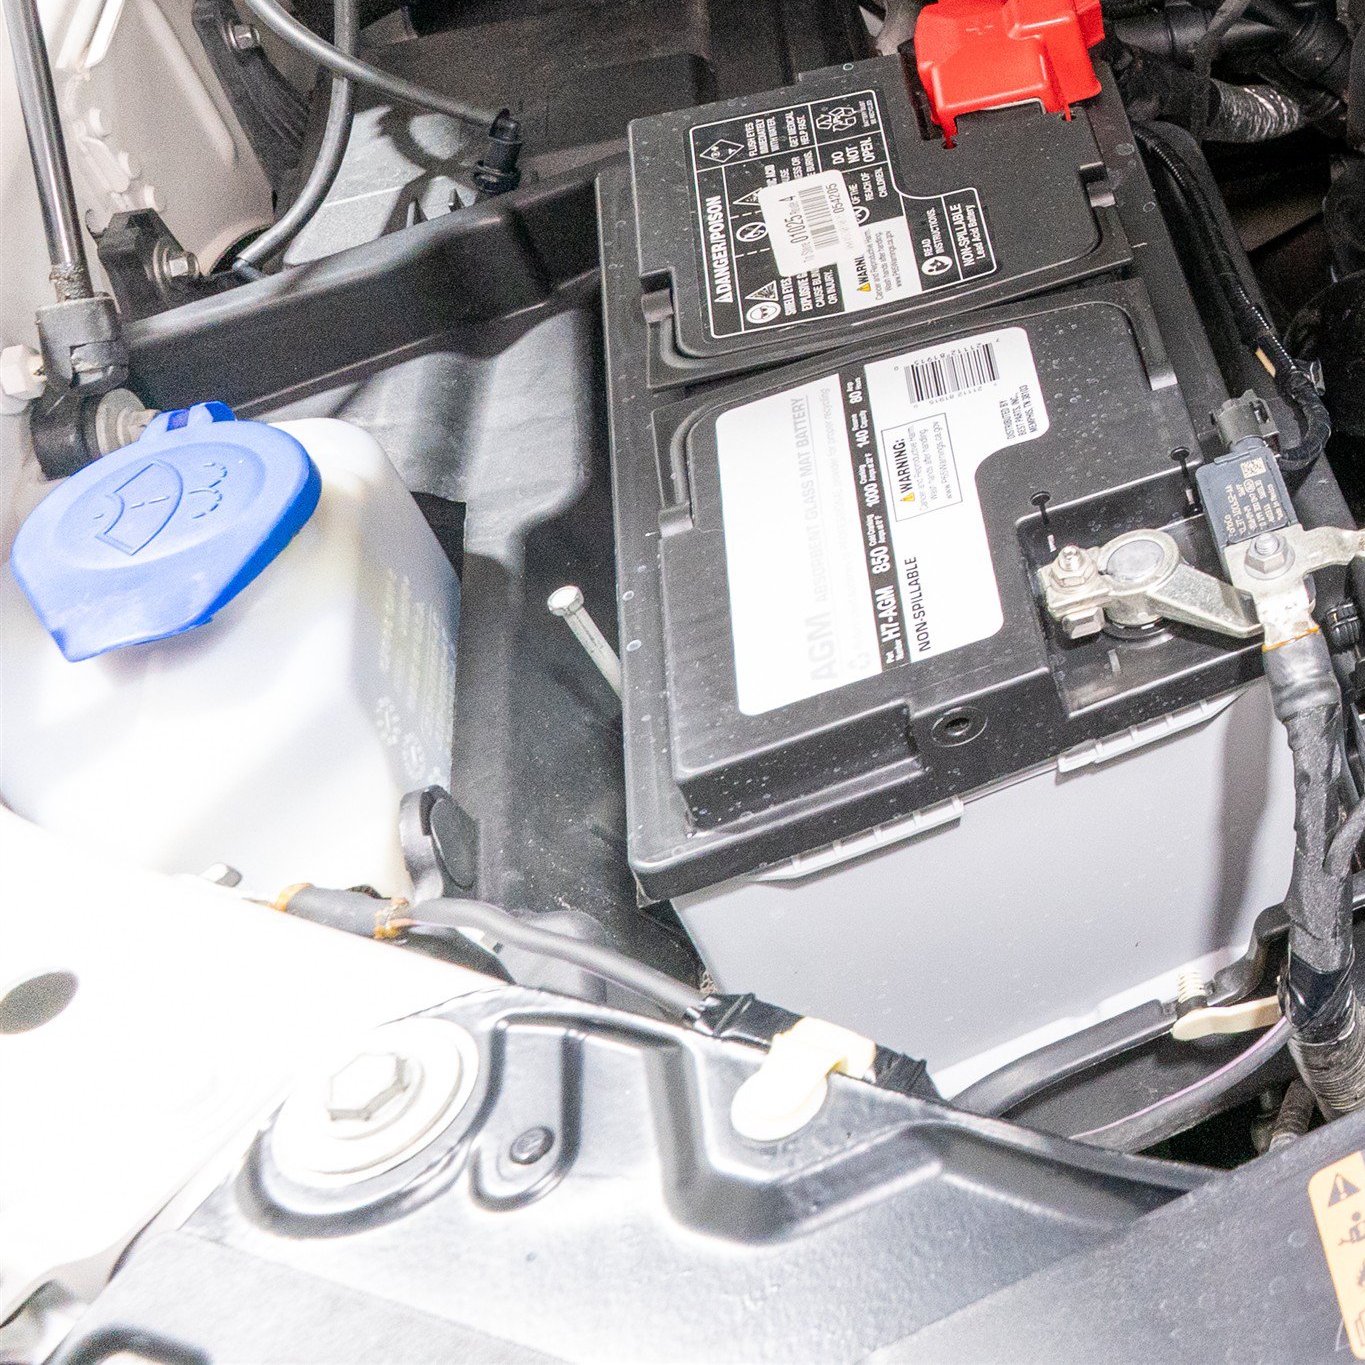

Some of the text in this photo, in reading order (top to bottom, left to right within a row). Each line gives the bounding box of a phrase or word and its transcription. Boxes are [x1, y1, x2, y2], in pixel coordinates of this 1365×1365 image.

[744, 122, 758, 157] FLUSH EYES
[755, 119, 769, 154] IMMEDIATELY
[785, 110, 799, 148] GET MEDICAL
[799, 130, 810, 145] HELP
[770, 137, 780, 152] WITH
[831, 151, 845, 165] DO
[845, 146, 860, 164] NOT
[859, 136, 876, 163] OPEN.
[825, 183, 845, 214] 054205
[860, 172, 874, 201] REACH OF
[783, 214, 809, 244] 01025
[949, 203, 976, 267] NON-SPILLABLE
[965, 204, 986, 259] Lead Acid Battery
[705, 195, 732, 294] DANGER/POISON
[921, 238, 933, 257] READ
[782, 293, 797, 316] SHIELD
[797, 278, 813, 312] EXPLOSIVE
[813, 285, 826, 308] CAUSE
[827, 293, 838, 305] OR
[819, 387, 832, 420] recycling
[848, 390, 863, 404] 80
[999, 400, 1016, 440] DISTRIBUTED BY
[1015, 424, 1027, 436] BEST
[855, 429, 870, 448] 140
[892, 438, 913, 493] WARNING:
[863, 482, 880, 507] 1000
[790, 397, 838, 681] AGM ABSORBENT GLASS MAT BATTERY
[869, 546, 891, 574] 850
[874, 585, 901, 643] H7-AGM
[904, 556, 931, 652] NON-SPILLABLE
